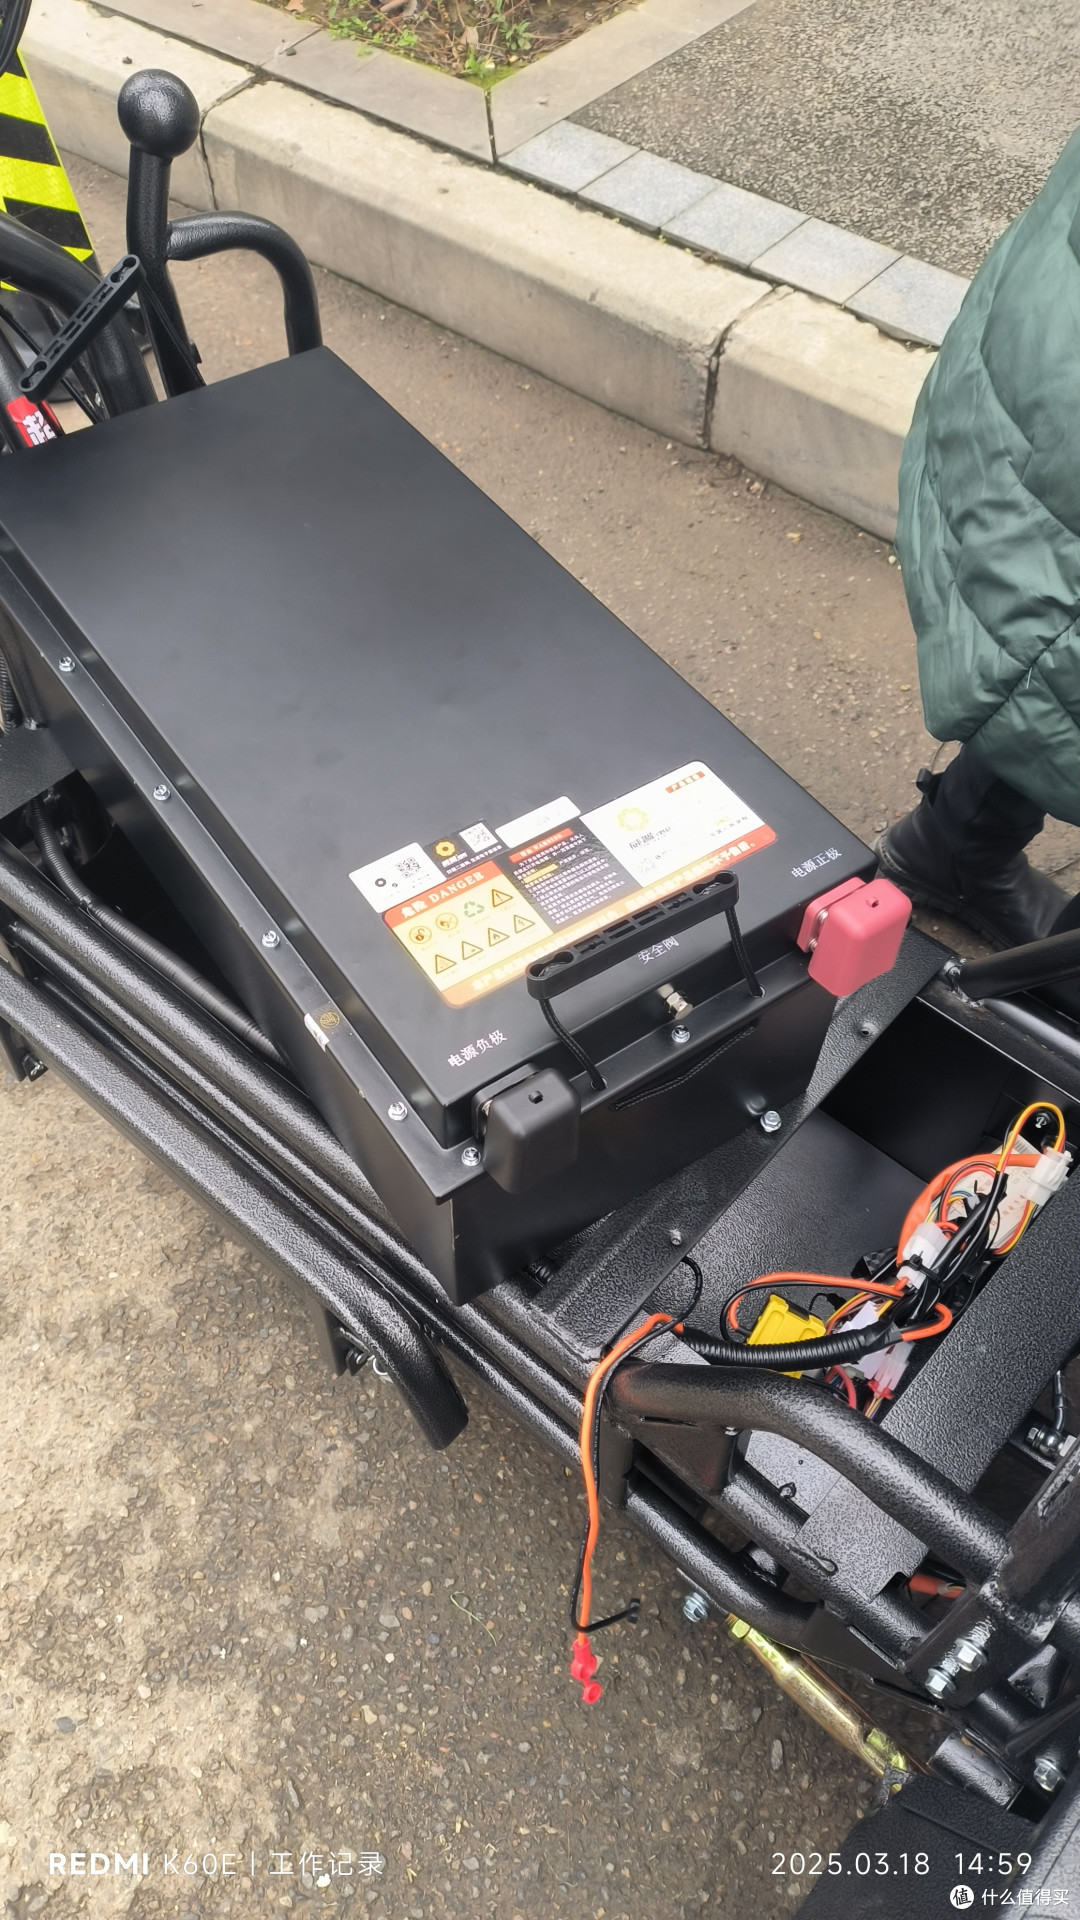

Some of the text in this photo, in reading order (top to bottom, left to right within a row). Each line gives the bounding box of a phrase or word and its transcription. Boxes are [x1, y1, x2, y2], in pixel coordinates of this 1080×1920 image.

[790, 847, 843, 878] 电源正极
[428, 871, 485, 902] DANGER
[637, 936, 680, 965] 安全阀
[447, 1029, 508, 1067] 电源负极
